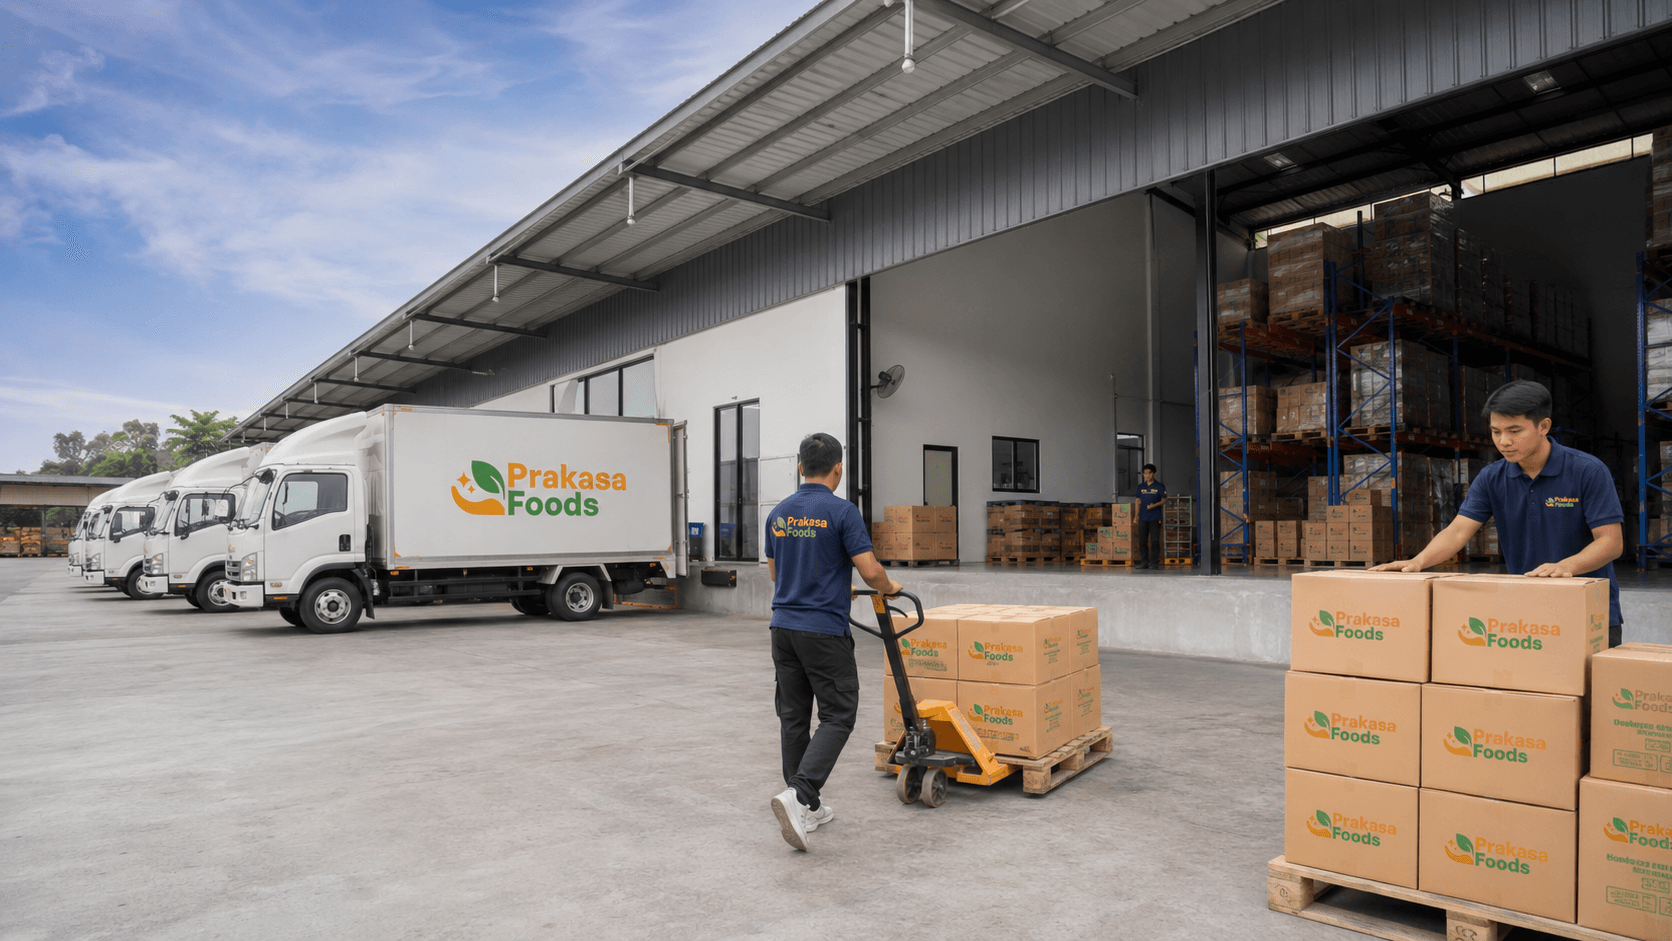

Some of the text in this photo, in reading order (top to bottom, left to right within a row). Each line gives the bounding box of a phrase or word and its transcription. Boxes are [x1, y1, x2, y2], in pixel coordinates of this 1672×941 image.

[507, 462, 627, 491] Prakasa
[507, 490, 599, 516] Foods
[787, 516, 828, 528] Prakasa
[786, 527, 816, 538] Foods
[1335, 610, 1400, 628] Prakasa
[1488, 618, 1561, 637] Prakasa
[1335, 625, 1384, 641] Foods
[1487, 633, 1543, 650] Foods
[910, 647, 939, 657] Foods
[984, 651, 1014, 662] Foods
[983, 713, 1013, 725] Foods
[1331, 712, 1396, 733] Prakasa
[1331, 727, 1380, 745] Foods
[1473, 728, 1546, 750] Prakasa
[1473, 744, 1528, 763] Foods
[1333, 812, 1397, 836] Prakasa
[1332, 826, 1381, 846] Foods
[1475, 836, 1548, 862] Prakasa
[1475, 852, 1530, 874] Foods
